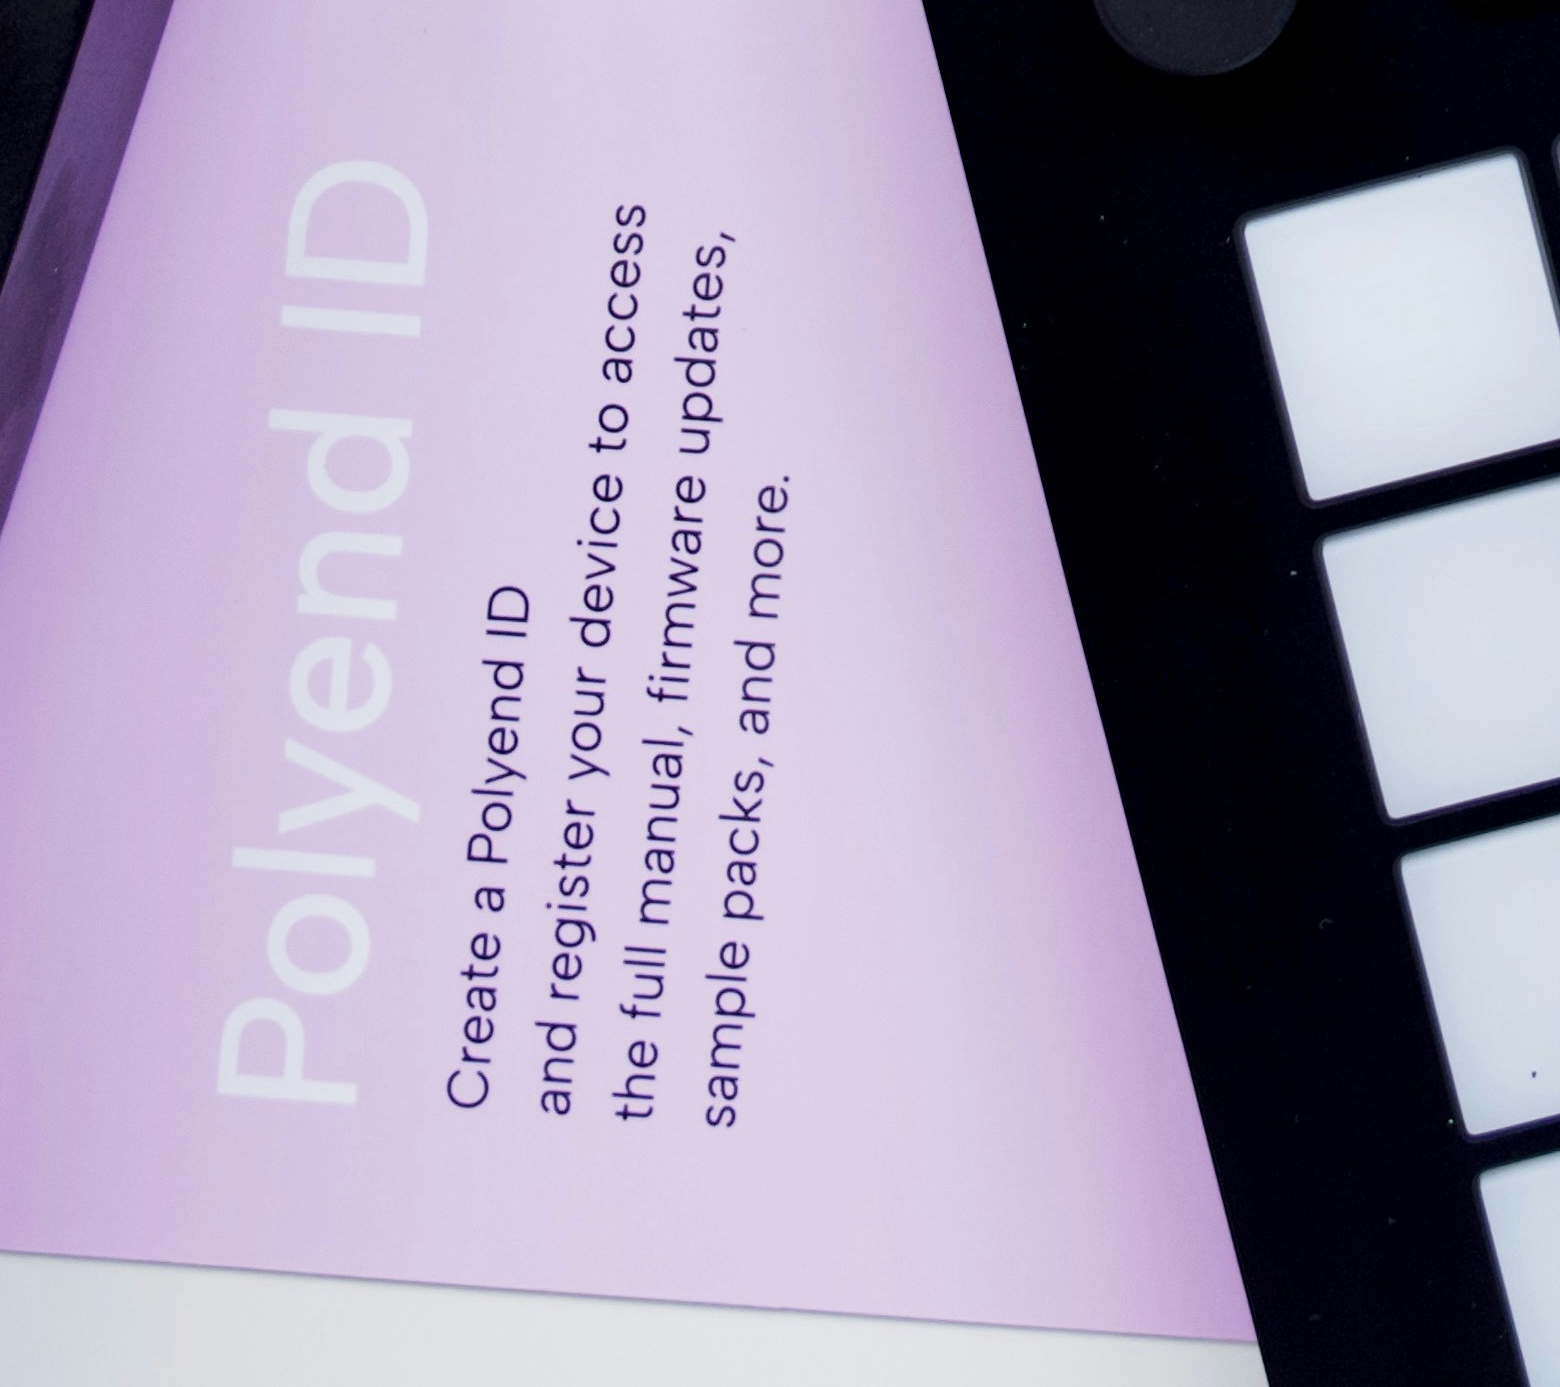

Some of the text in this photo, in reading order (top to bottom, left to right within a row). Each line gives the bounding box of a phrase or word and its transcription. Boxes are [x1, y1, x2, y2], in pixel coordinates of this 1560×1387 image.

[216, 158, 430, 1106] Polyend ID
[445, 584, 530, 1109] Create a Polyend ID
[534, 203, 647, 1116] and register your device to access
[611, 231, 736, 1121] the full manual, firmware updates,
[704, 474, 790, 1127] sample packs, and more.
